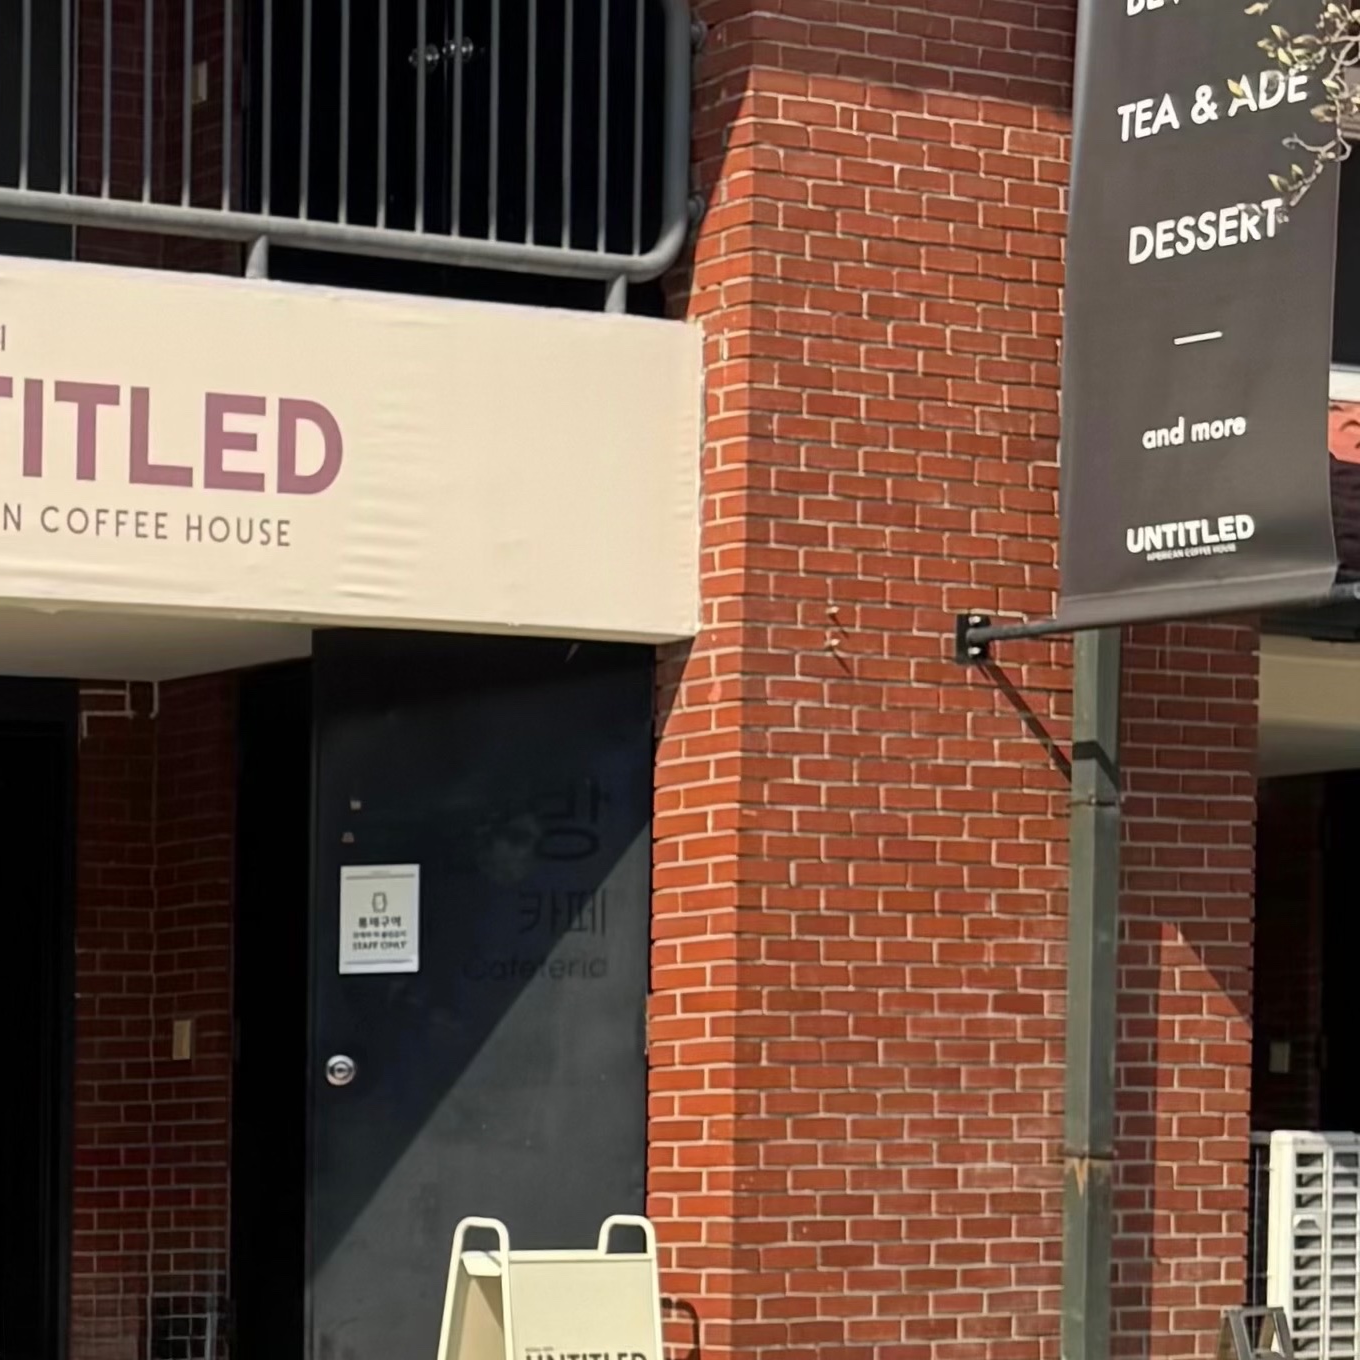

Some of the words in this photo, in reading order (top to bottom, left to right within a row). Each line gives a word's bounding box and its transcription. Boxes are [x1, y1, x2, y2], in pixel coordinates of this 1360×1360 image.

[1117, 93, 1180, 142] TEA
[1190, 85, 1219, 125] &
[1228, 69, 1310, 117] ADE
[1128, 198, 1283, 265] DESSERT
[1142, 416, 1185, 449] and
[1191, 416, 1247, 443] more
[40, 506, 169, 540] COFFEE
[185, 513, 292, 547] HOUSE
[1126, 514, 1255, 554] UNTITLED
[519, 888, 608, 938] 카페
